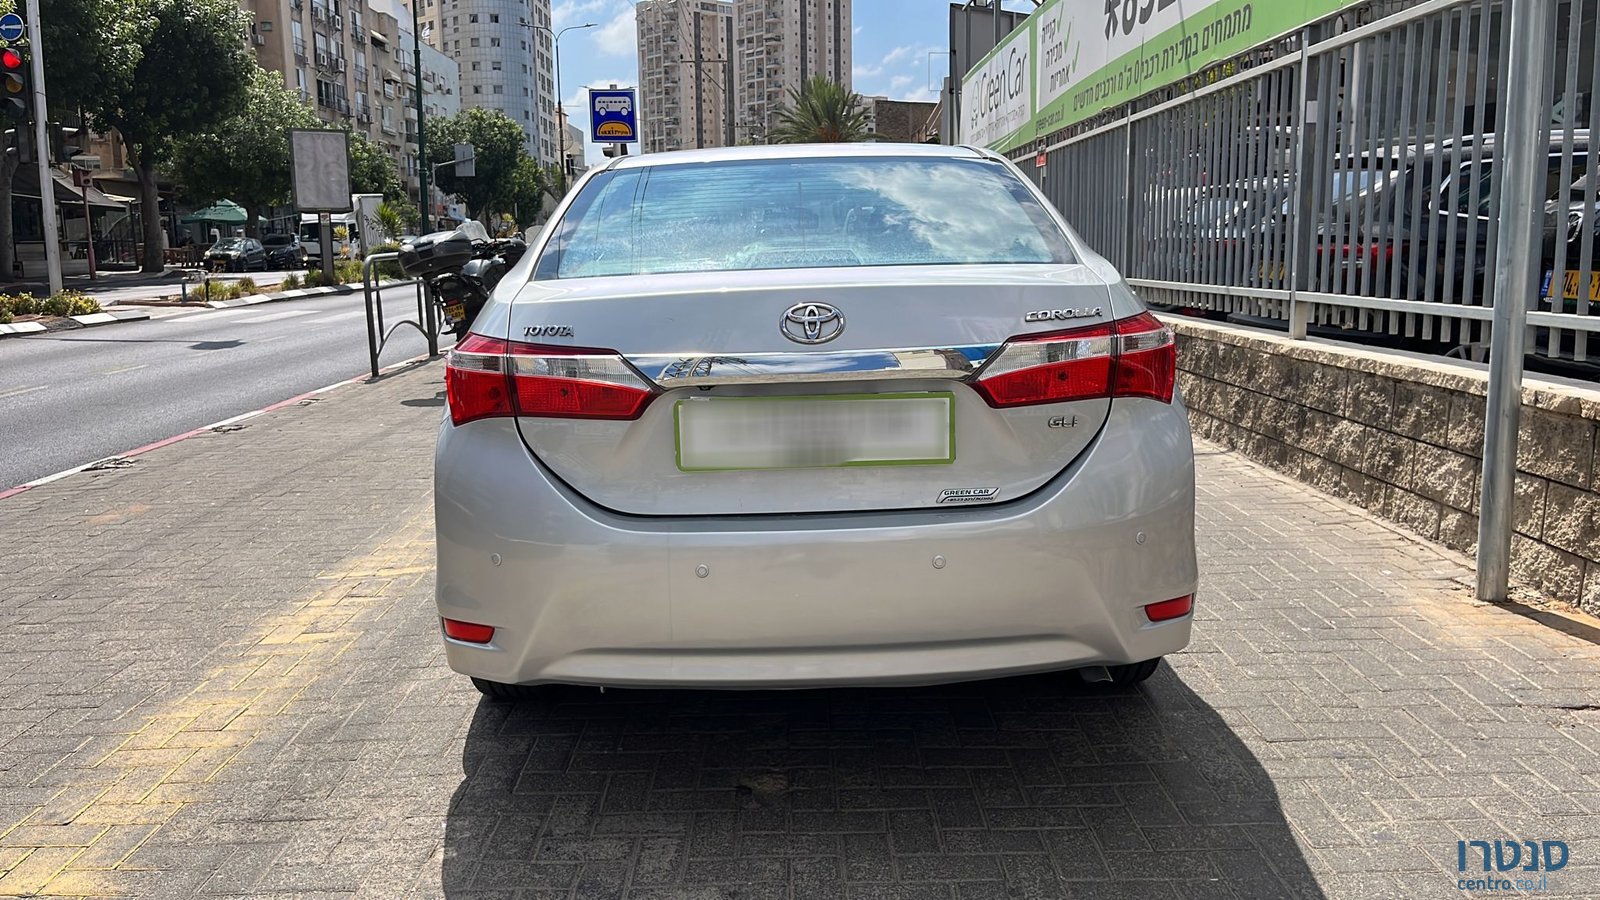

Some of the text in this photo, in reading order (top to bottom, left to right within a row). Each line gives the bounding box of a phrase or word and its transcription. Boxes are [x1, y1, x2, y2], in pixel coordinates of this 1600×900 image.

[1201, 3, 1252, 51] מתמחים
[1045, 41, 1063, 68] מכירה
[1161, 32, 1199, 72] במכירת
[1008, 47, 1027, 100] Car
[523, 324, 575, 337] TOYOTA
[1025, 306, 1103, 322] COROLLA
